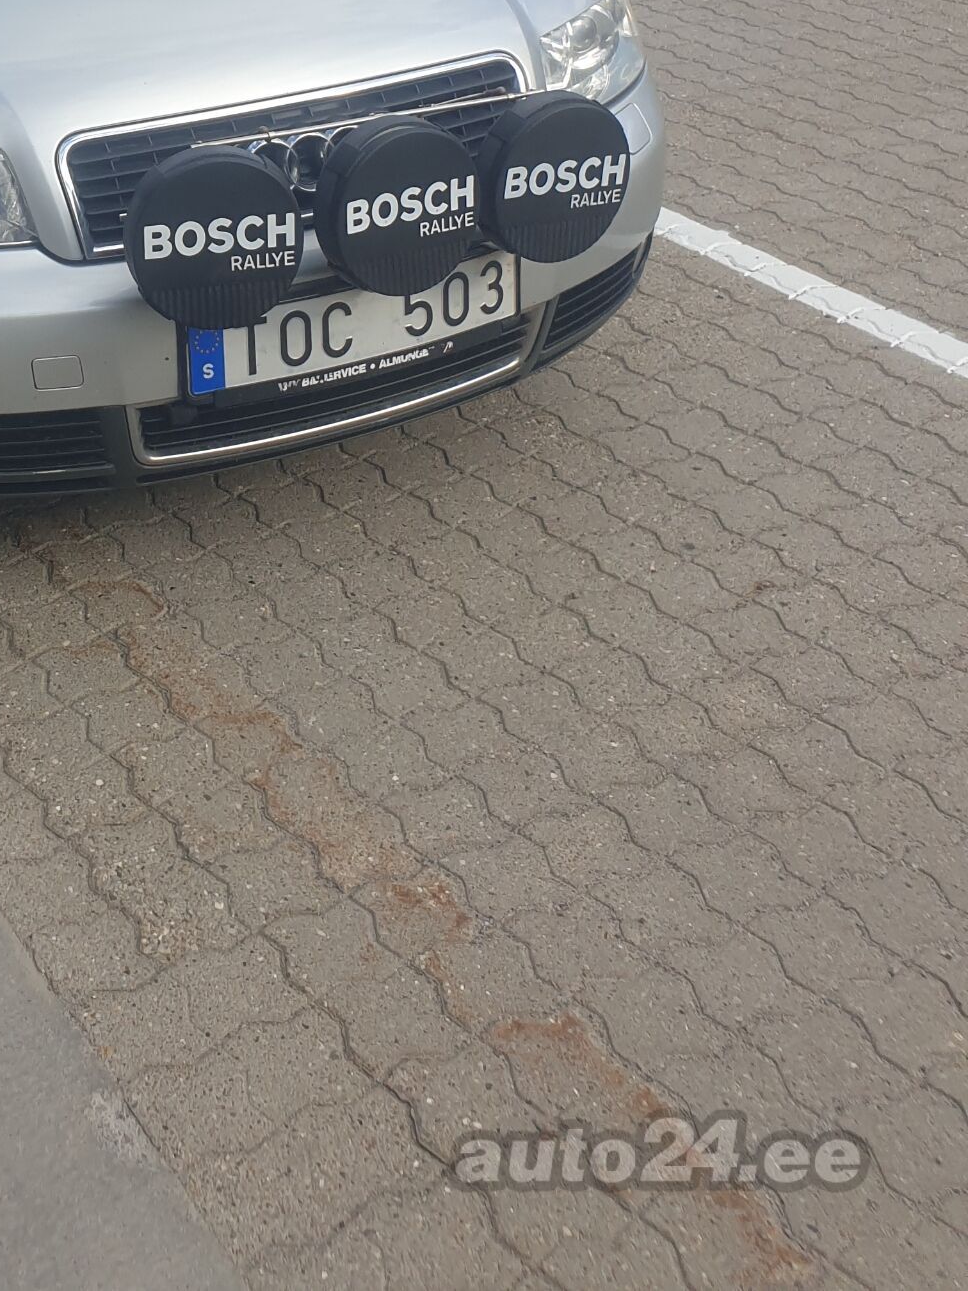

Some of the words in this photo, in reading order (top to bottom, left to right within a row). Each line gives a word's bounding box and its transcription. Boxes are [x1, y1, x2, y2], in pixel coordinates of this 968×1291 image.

[503, 153, 627, 200] BOSCH
[346, 175, 475, 235] BOSCH
[570, 188, 622, 210] RALLYE
[143, 212, 296, 260] BOSCH
[418, 213, 475, 238] RALLYE
[230, 250, 296, 272] RALLYE
[242, 301, 353, 376] TOC
[403, 259, 505, 337] 503
[202, 363, 214, 379] S
